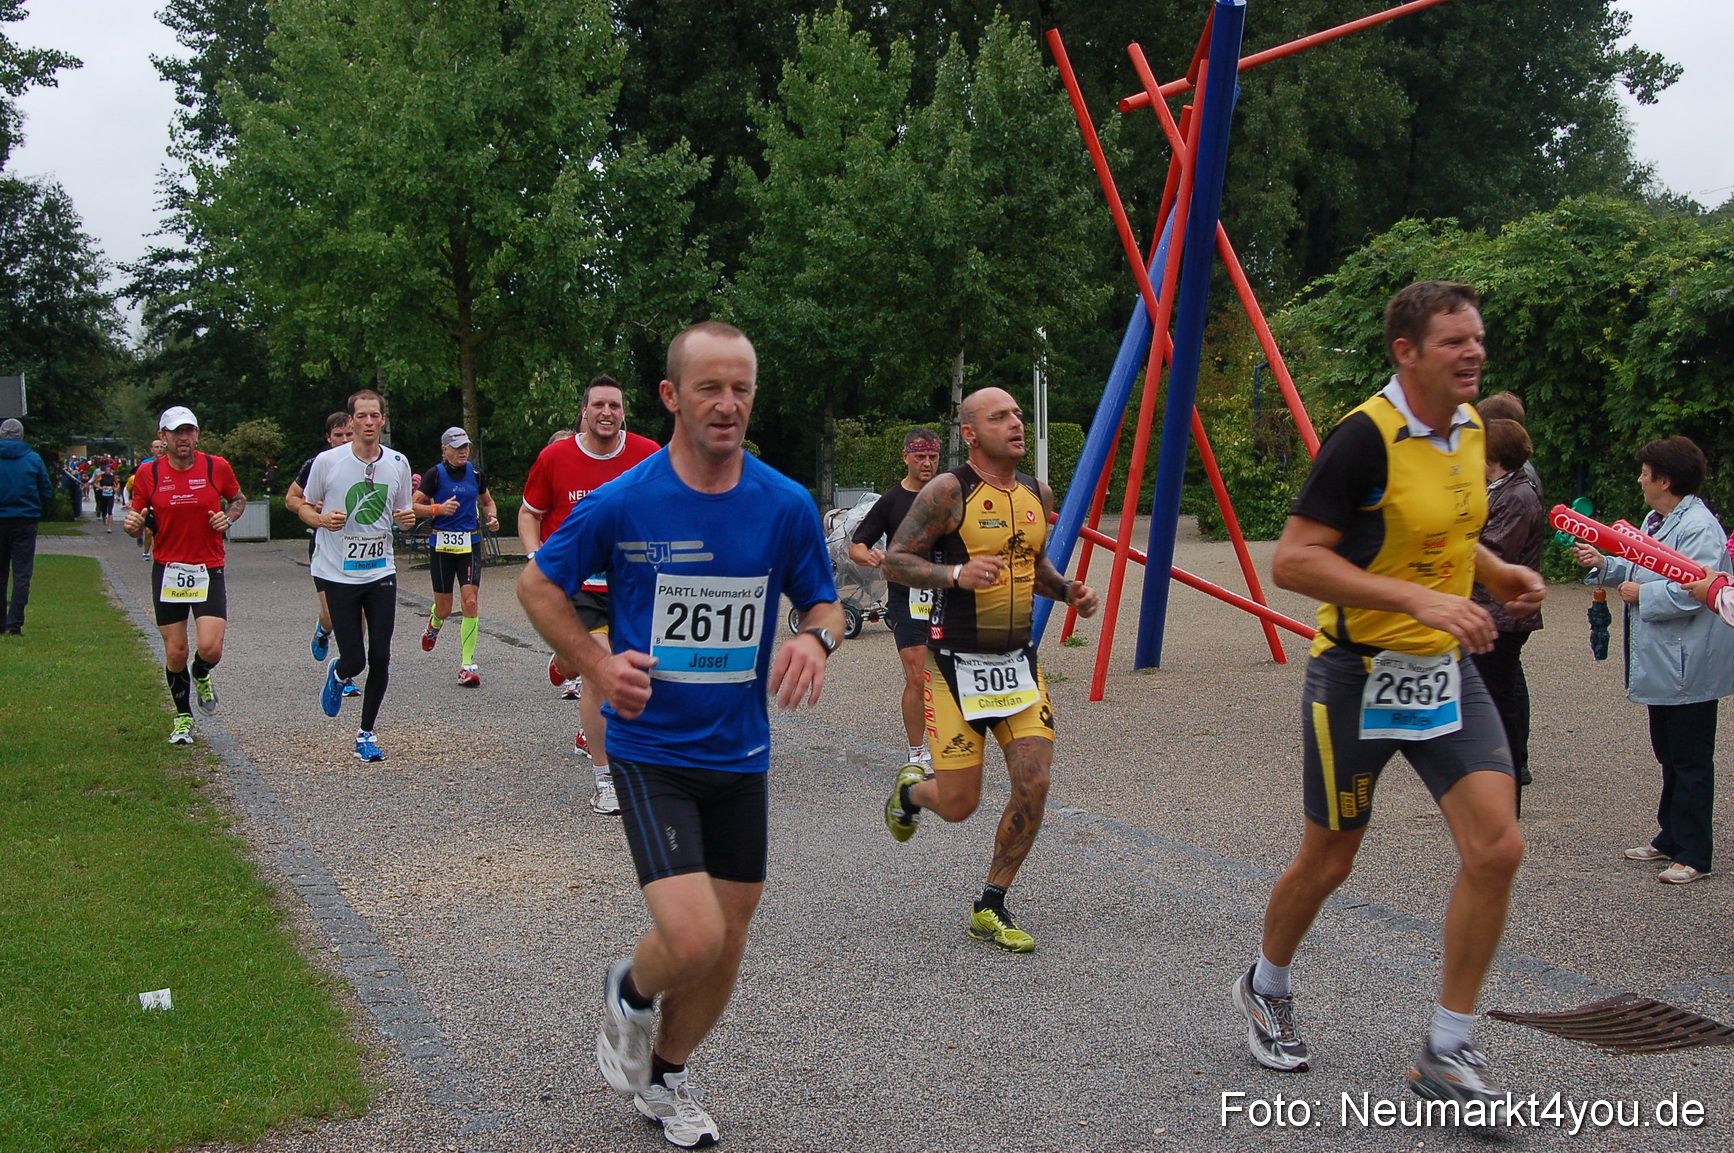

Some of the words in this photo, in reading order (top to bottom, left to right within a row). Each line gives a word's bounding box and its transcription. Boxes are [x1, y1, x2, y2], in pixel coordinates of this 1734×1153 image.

[443, 533, 464, 545] 335
[347, 541, 384, 559] 2748
[1615, 541, 1658, 570] BKK
[177, 572, 195, 588] 58
[1661, 562, 1701, 583] udi
[658, 585, 697, 597] PARTL
[700, 588, 752, 599] Neumarkt
[919, 588, 934, 603] 5
[664, 602, 756, 643] 2610
[689, 653, 729, 668] Josef
[973, 667, 1019, 692] 509
[1374, 670, 1453, 706] 2652
[978, 696, 1023, 709] Christian
